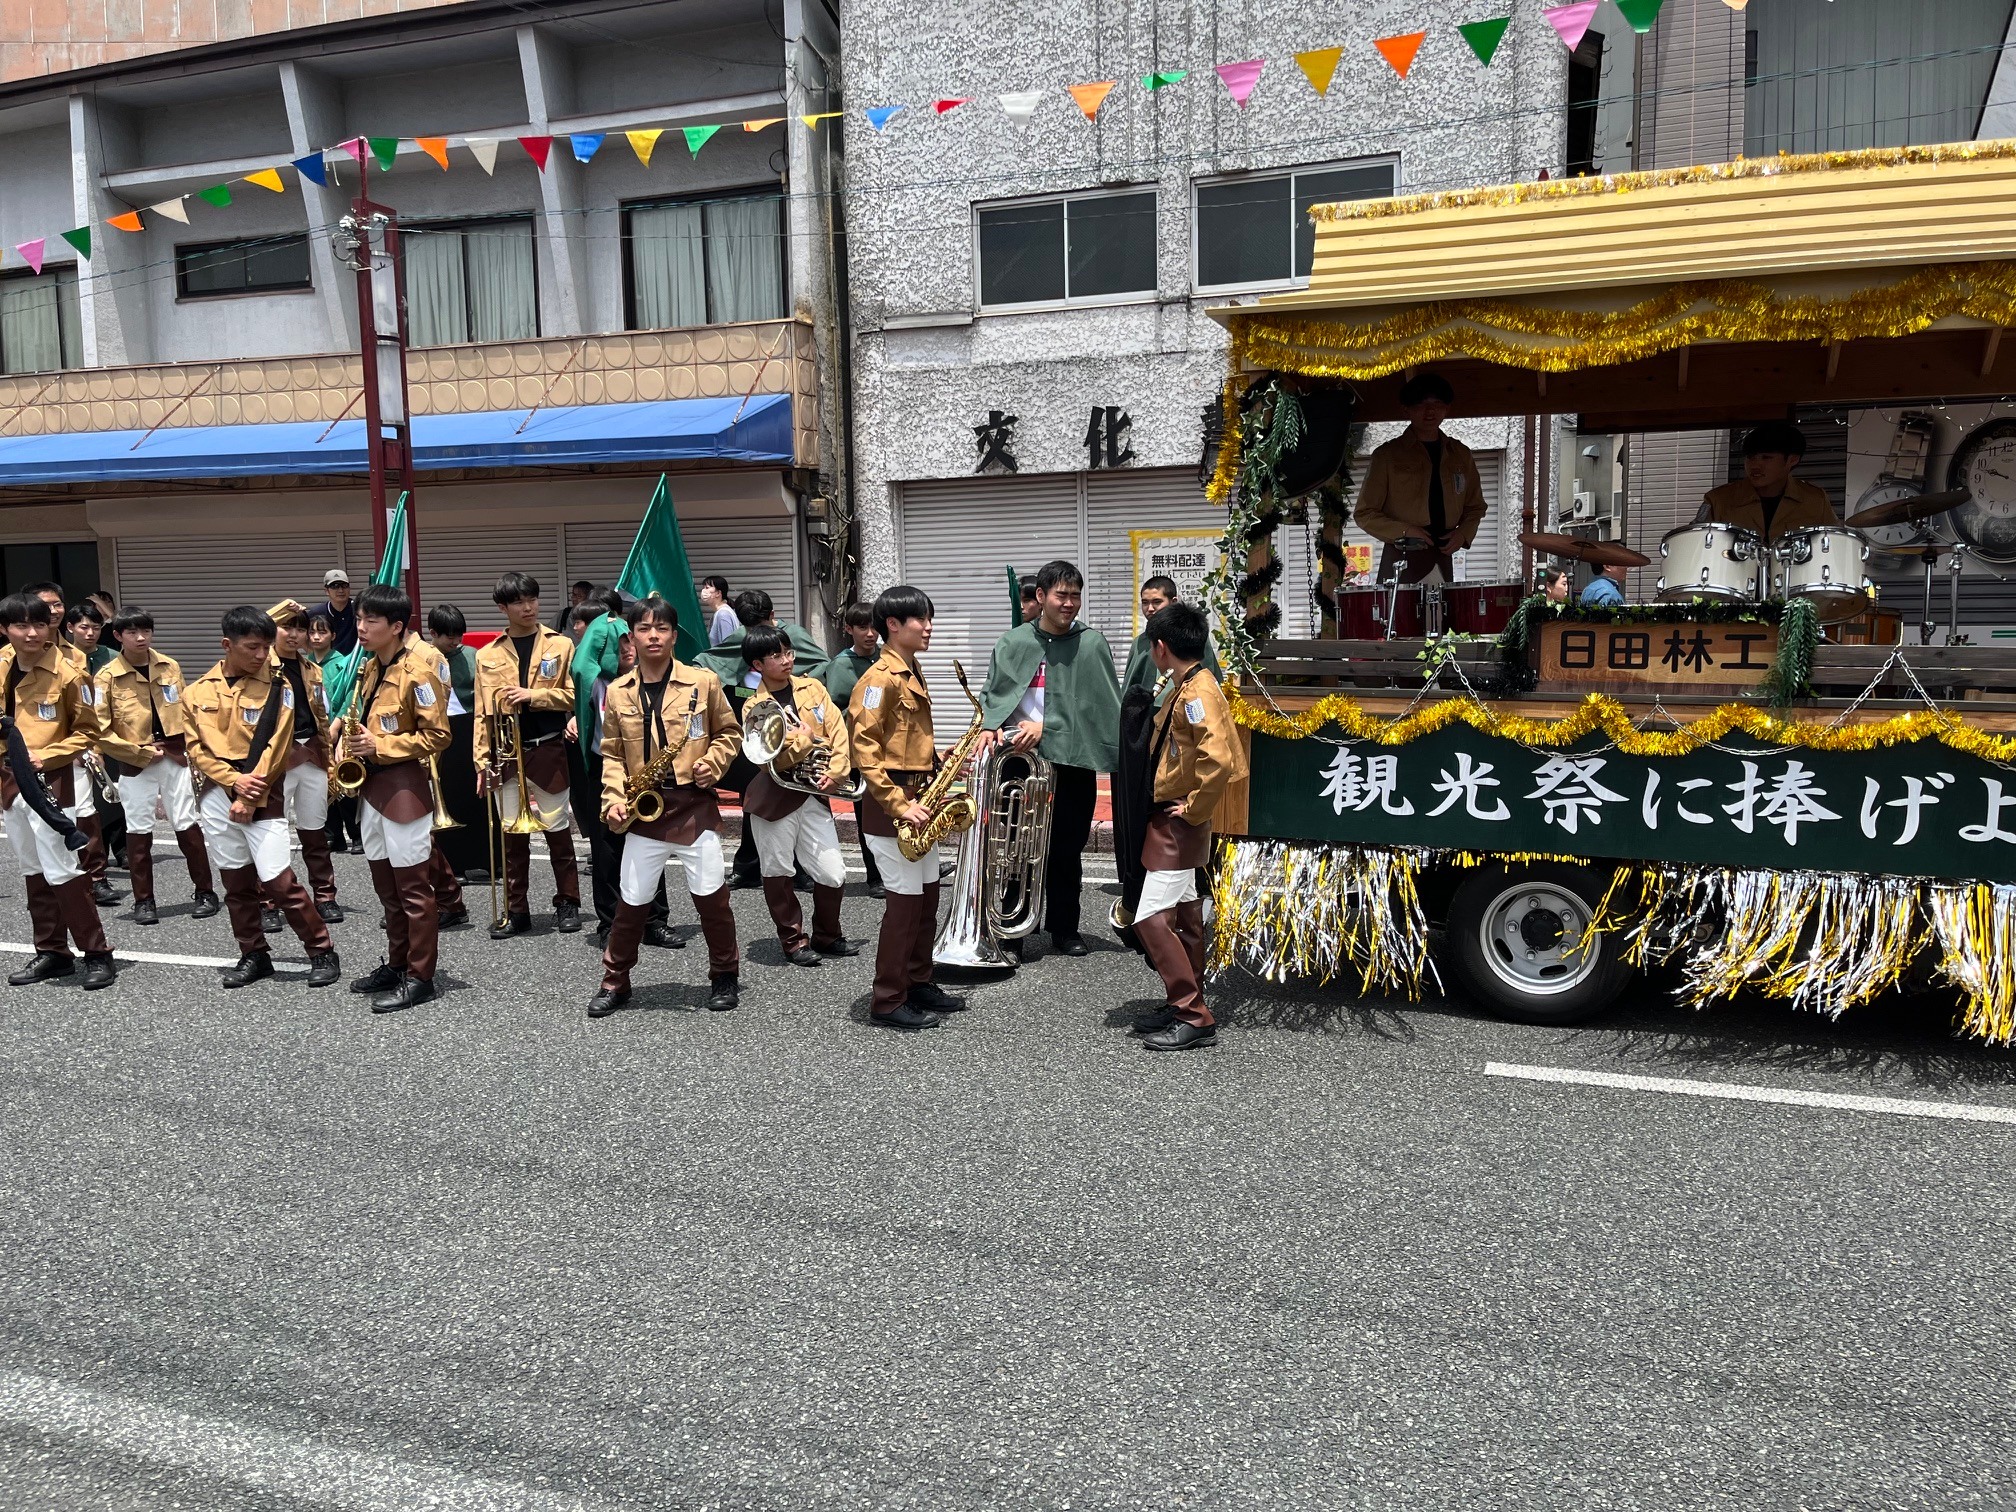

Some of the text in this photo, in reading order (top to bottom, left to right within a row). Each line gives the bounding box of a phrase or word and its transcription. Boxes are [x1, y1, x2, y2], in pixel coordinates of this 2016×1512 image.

[1988, 446, 1997, 457] 11
[1976, 458, 1987, 470] 10
[1974, 473, 1982, 484] 9
[1978, 488, 1985, 499] 8
[1989, 501, 1995, 511] 7
[2002, 503, 2009, 514] 6
[1152, 553, 1206, 568] 無料配達
[1560, 629, 1769, 673] 日田林工
[1318, 747, 2016, 846] 観光祭に捧げよ
